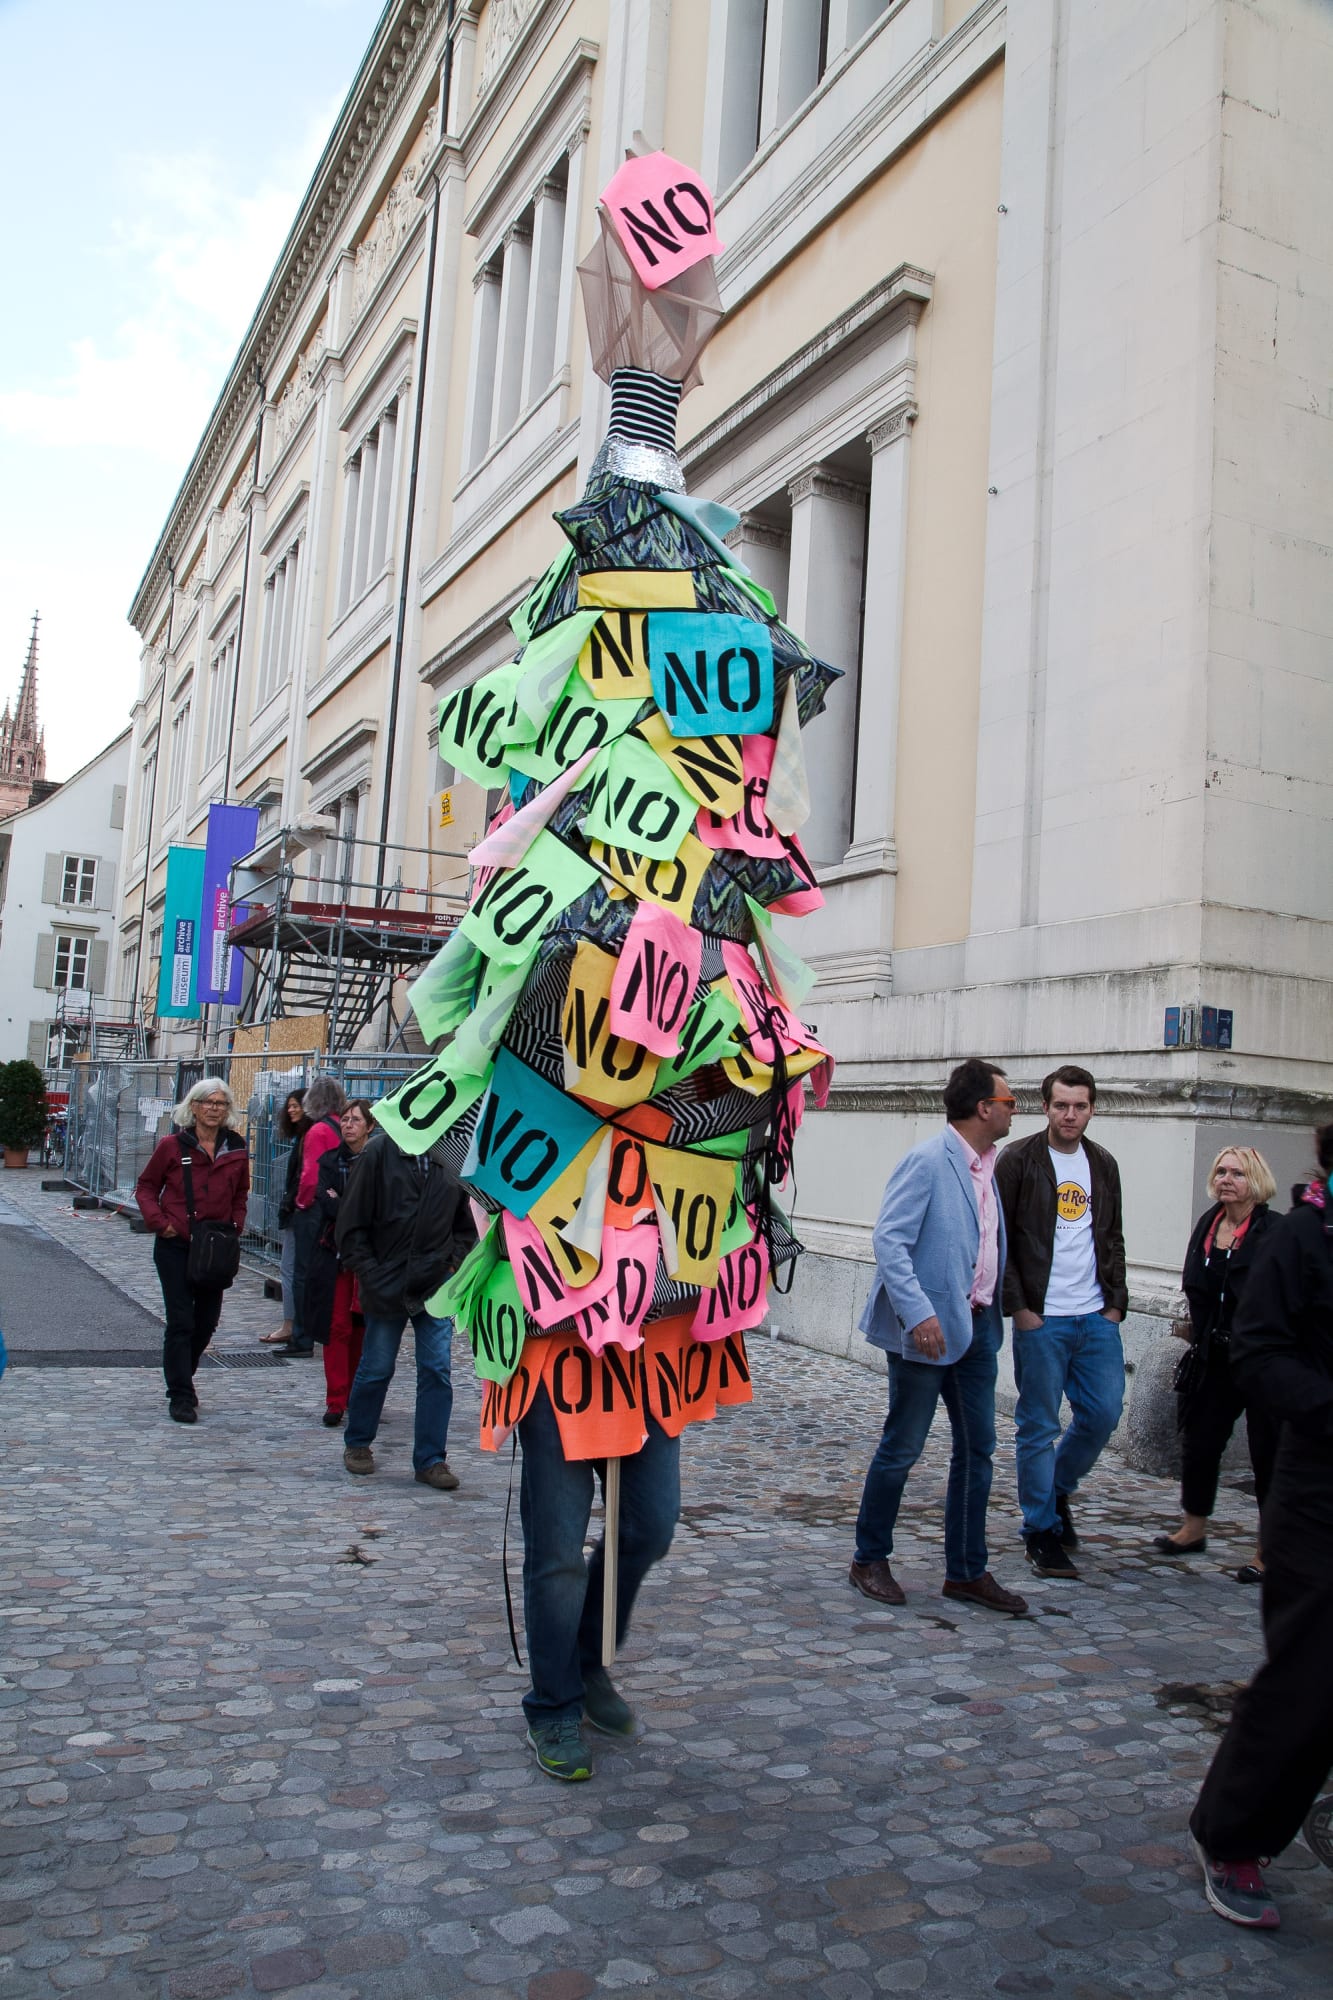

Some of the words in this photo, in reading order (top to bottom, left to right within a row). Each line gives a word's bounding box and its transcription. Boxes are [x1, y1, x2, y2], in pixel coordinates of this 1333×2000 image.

[619, 182, 711, 266] NO
[590, 613, 649, 679] N
[664, 648, 761, 716] NO
[176, 921, 186, 953] archive
[217, 891, 228, 929] archive
[472, 867, 553, 945] NO
[180, 959, 190, 1004] museum
[620, 939, 689, 1033] NO
[477, 1093, 559, 1191] NO
[707, 1248, 762, 1325] NO
[472, 1295, 519, 1370] NO
